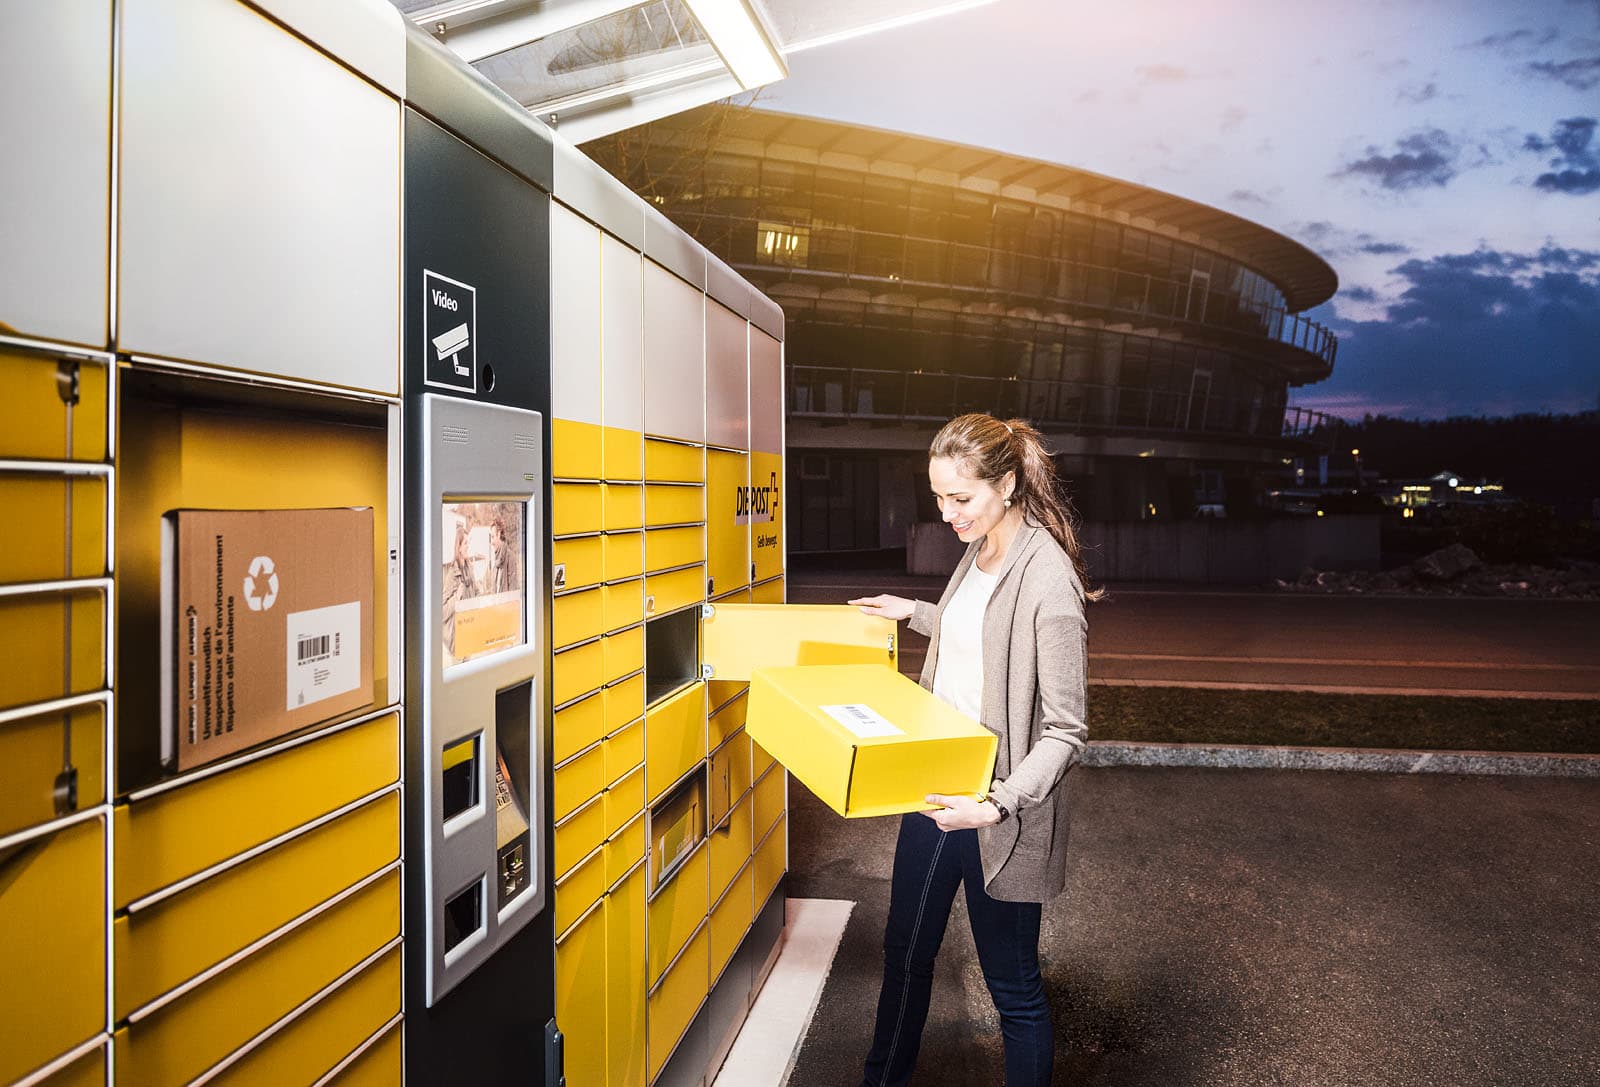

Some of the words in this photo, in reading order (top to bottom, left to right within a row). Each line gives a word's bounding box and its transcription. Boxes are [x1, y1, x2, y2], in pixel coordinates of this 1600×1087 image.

[432, 289, 458, 312] Video
[736, 486, 749, 517] DIE
[750, 486, 770, 515] POST
[214, 535, 223, 636] l'environnement
[214, 640, 223, 654] de
[226, 596, 234, 679] dell'ambiente
[203, 626, 211, 740] Umweltfreundlich
[214, 658, 224, 736] Respectueux
[226, 682, 236, 732] Rispetto
